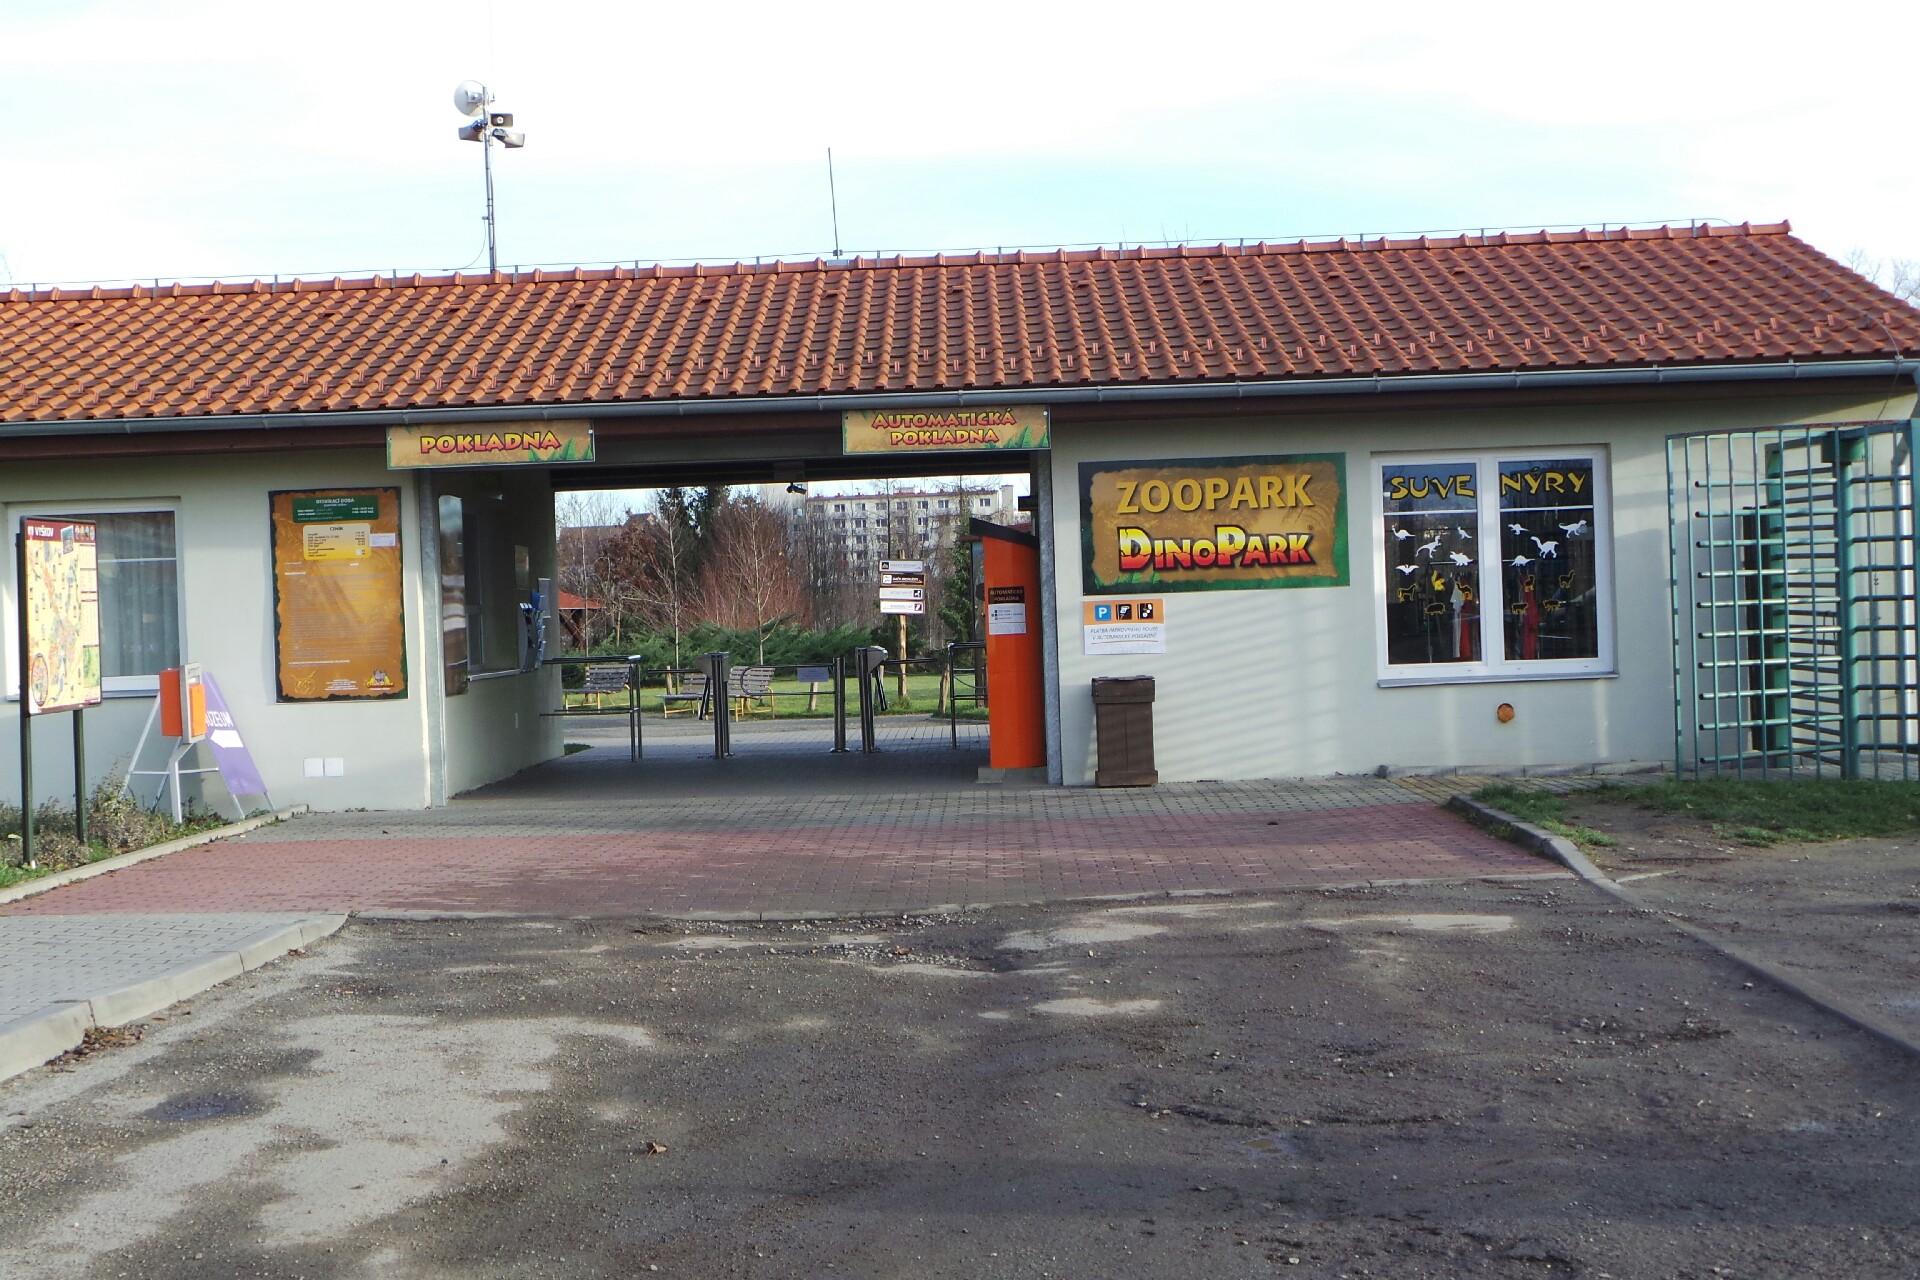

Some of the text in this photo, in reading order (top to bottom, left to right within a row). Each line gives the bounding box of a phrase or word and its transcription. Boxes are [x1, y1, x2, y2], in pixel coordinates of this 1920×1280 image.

[871, 407, 1017, 430] AUTOMATICKÁ
[420, 430, 562, 455] POKLADNA
[890, 429, 1000, 446] POKLADNA
[1116, 474, 1314, 514] ZOOPARK
[1390, 474, 1476, 500] SUVE
